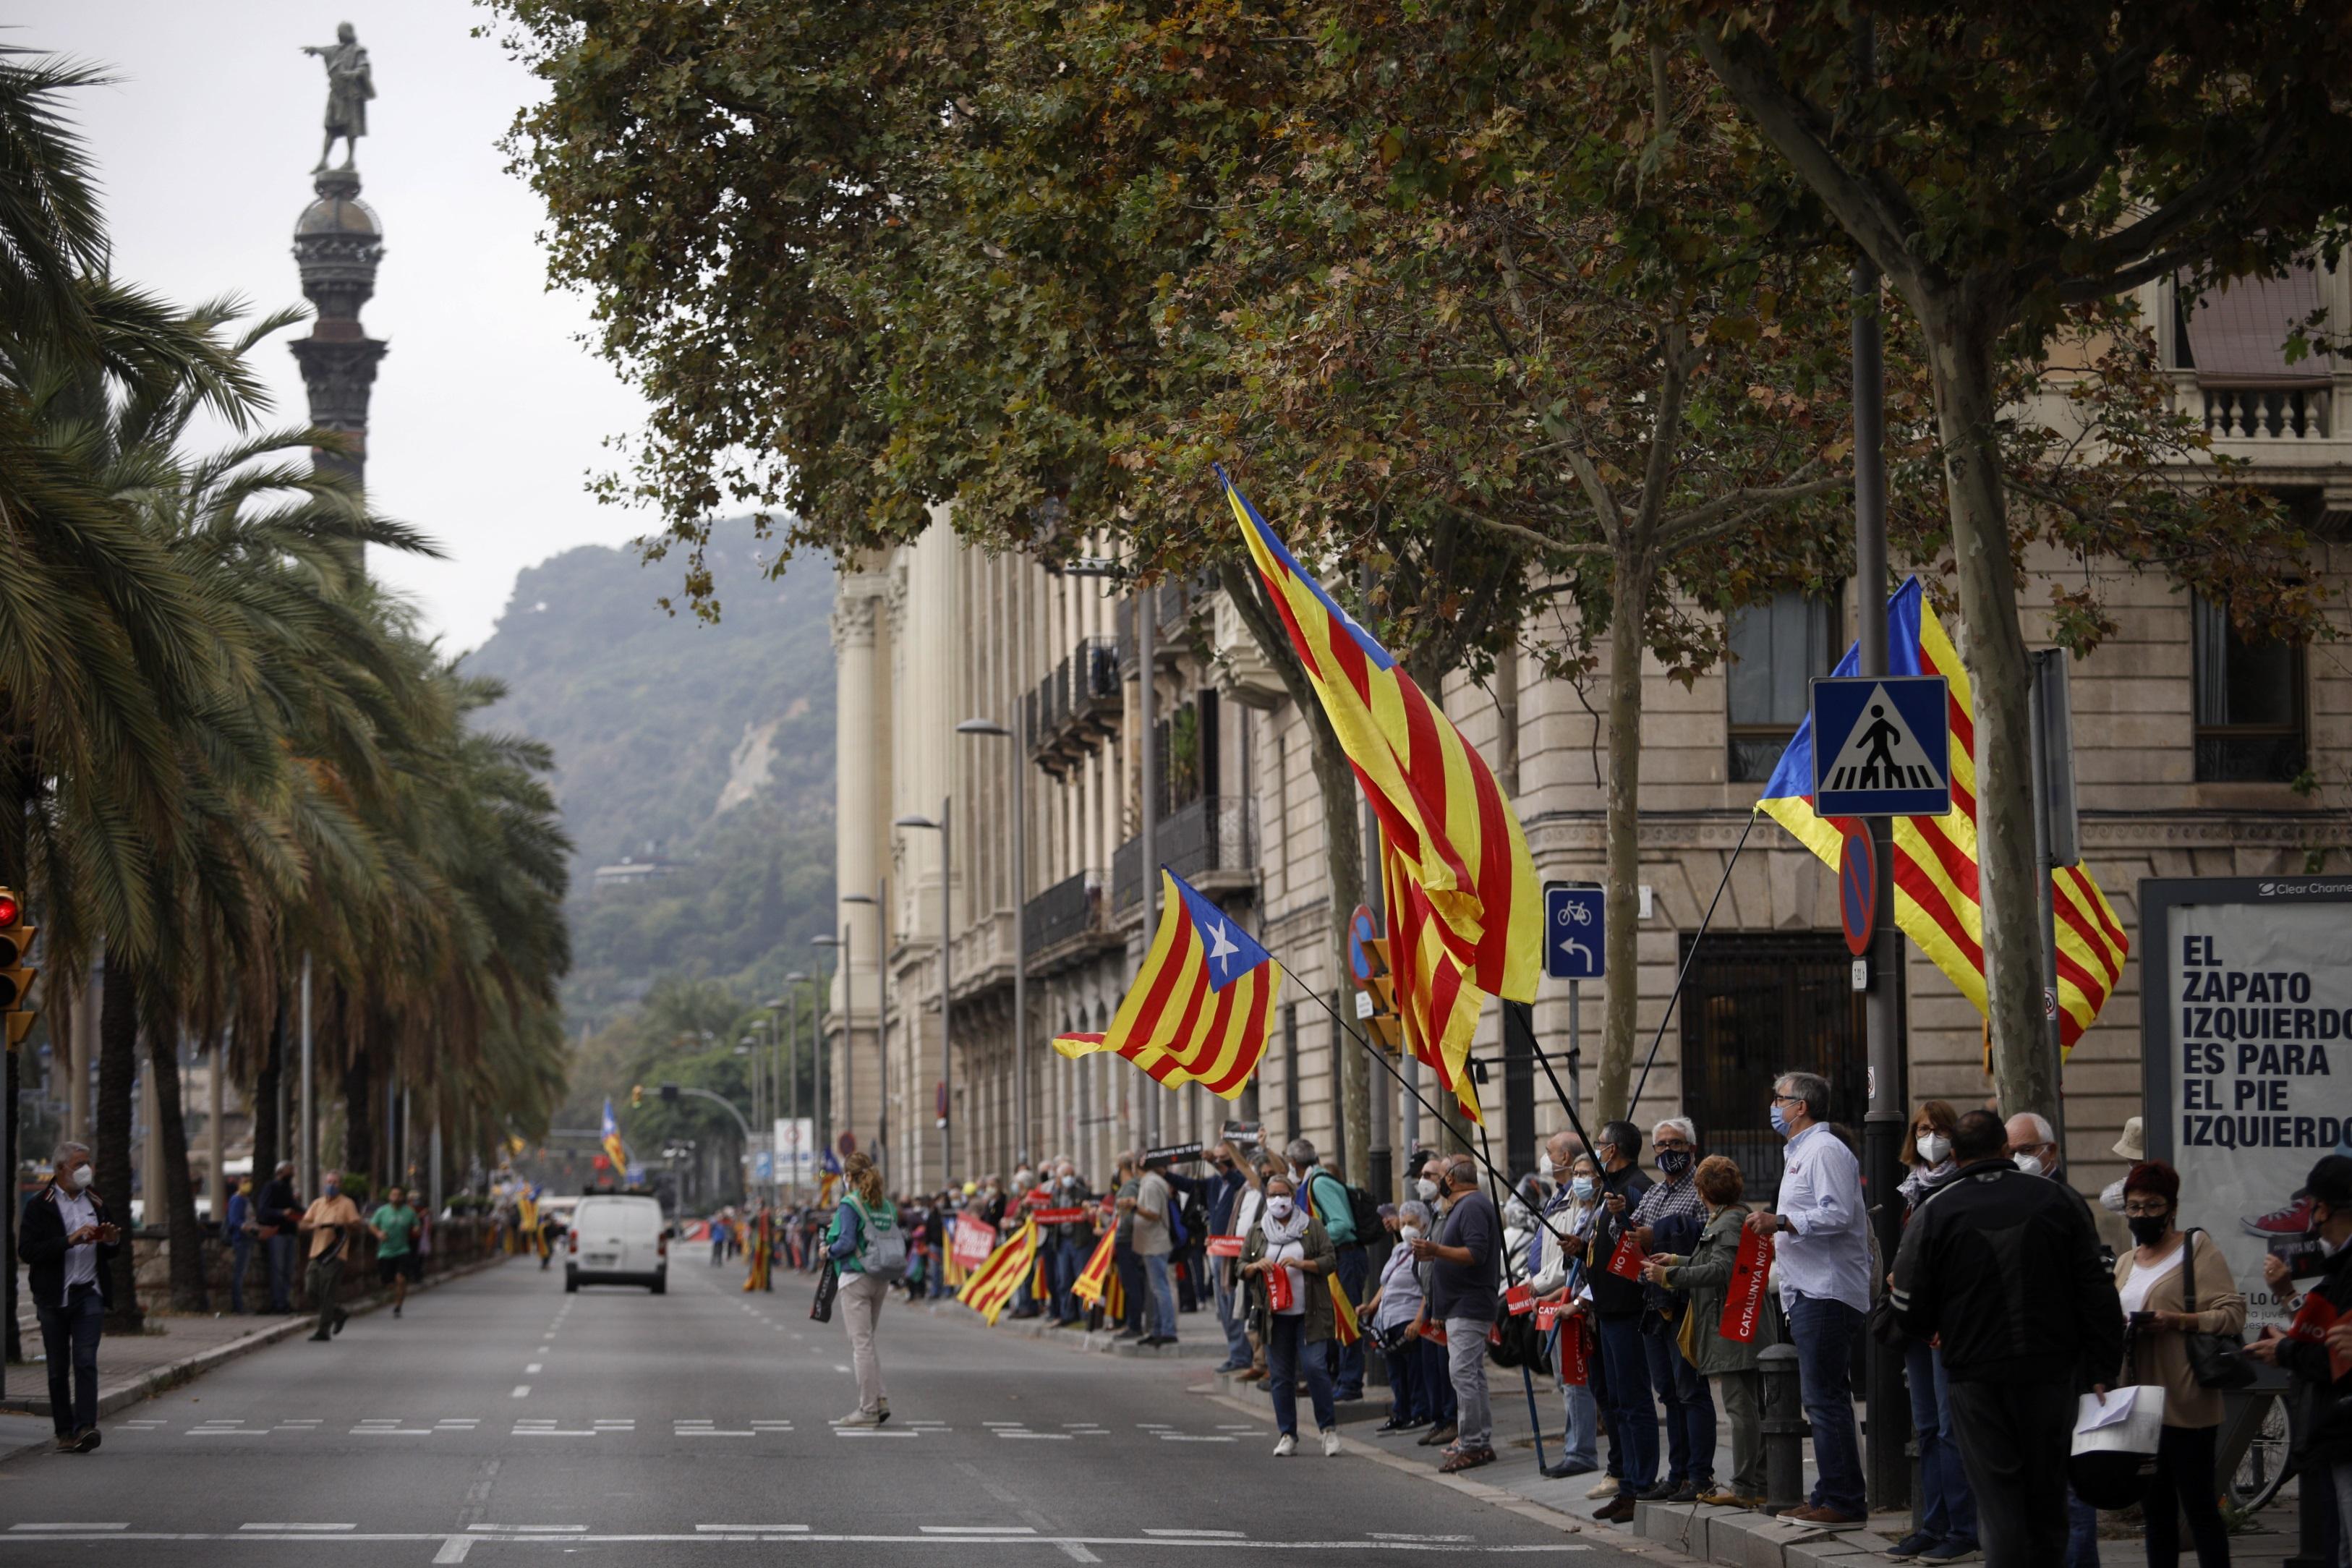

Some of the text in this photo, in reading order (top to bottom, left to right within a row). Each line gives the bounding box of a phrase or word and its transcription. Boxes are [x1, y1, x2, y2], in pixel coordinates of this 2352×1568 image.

[2276, 884, 2307, 894] Clear
[2183, 935, 2223, 967] EL
[2182, 971, 2311, 1004] ZAPATO
[2183, 1043, 2330, 1075] ES PARA
[2183, 1079, 2288, 1112] EL PIE
[1614, 1256, 1626, 1272] NO
[1739, 1270, 1763, 1337] CATALUNYA
[1755, 1251, 1768, 1266] NO
[2250, 1292, 2267, 1305] LO
